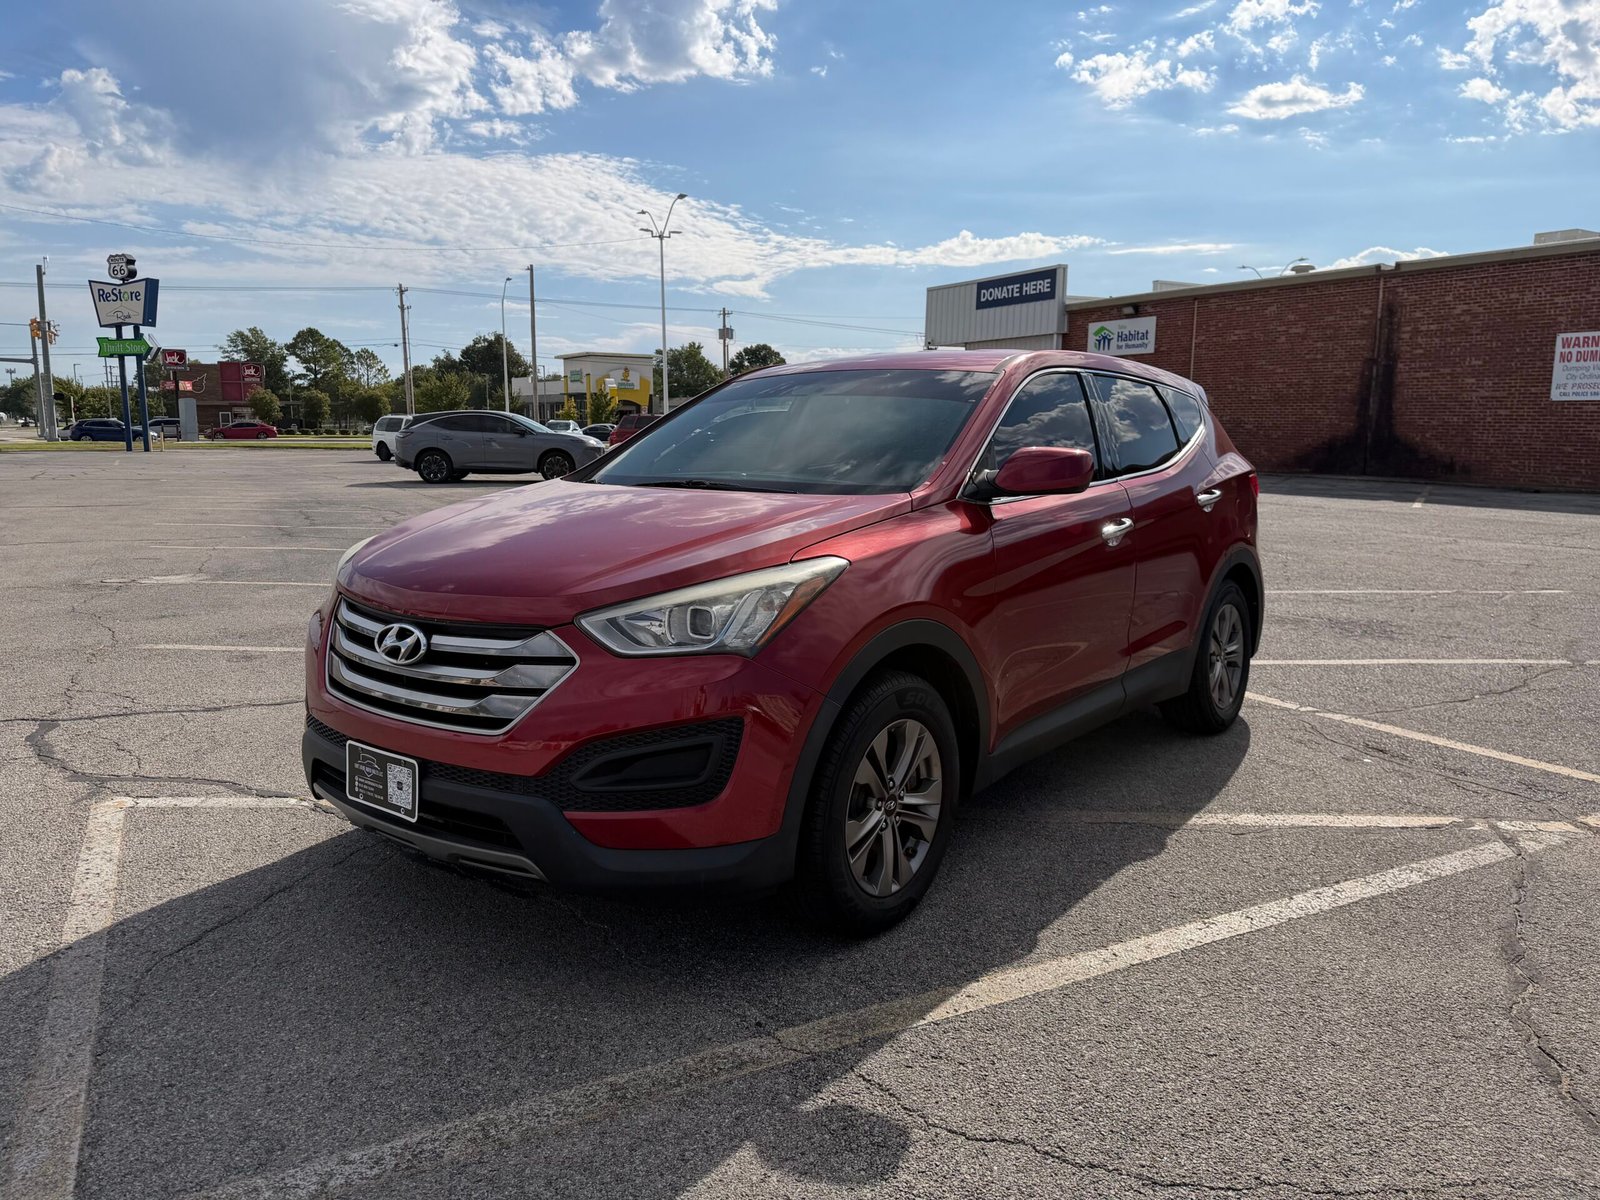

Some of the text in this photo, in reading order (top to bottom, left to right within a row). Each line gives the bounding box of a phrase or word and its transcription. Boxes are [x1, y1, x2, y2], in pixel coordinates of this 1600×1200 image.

[112, 265, 126, 276] 66
[97, 287, 142, 303] ReStore
[980, 278, 1051, 302] DONATE HERE
[1117, 329, 1149, 342] Habitat
[103, 342, 146, 353] Thrift Store
[164, 351, 185, 365] Jack
[1559, 349, 1600, 363] NO DUM
